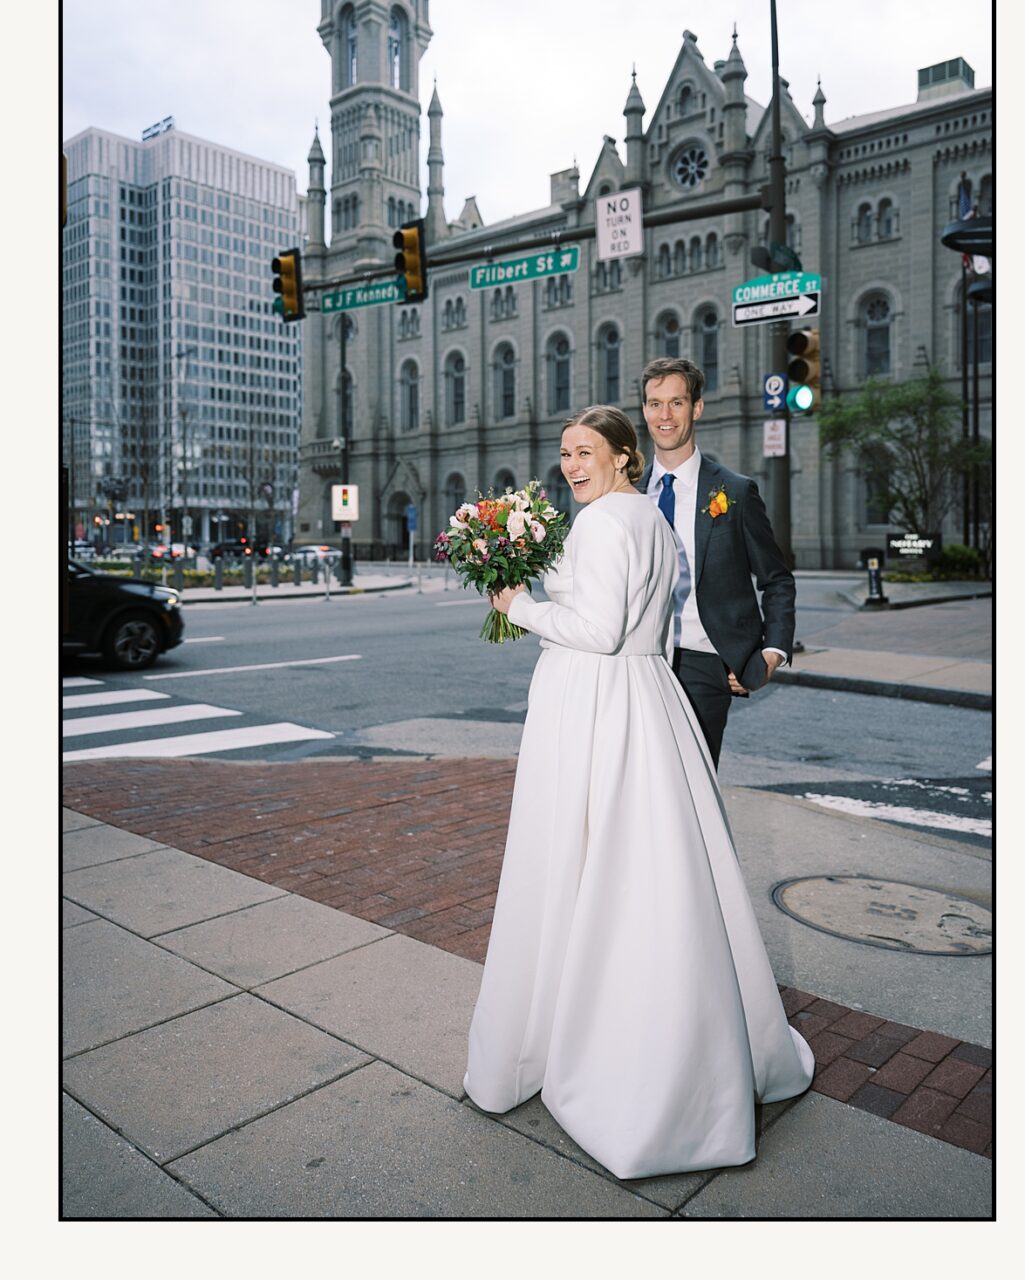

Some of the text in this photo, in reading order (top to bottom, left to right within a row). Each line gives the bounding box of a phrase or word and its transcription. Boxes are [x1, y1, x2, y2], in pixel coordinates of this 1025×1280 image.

[607, 198, 630, 215] NO
[606, 214, 632, 227] TURN
[611, 228, 627, 240] ON
[610, 240, 630, 254] RED
[476, 255, 554, 284] Filbert St
[335, 284, 399, 308] J F Kennedy
[735, 279, 818, 302] COMMERCE ST
[744, 302, 794, 318] ONE WAY
